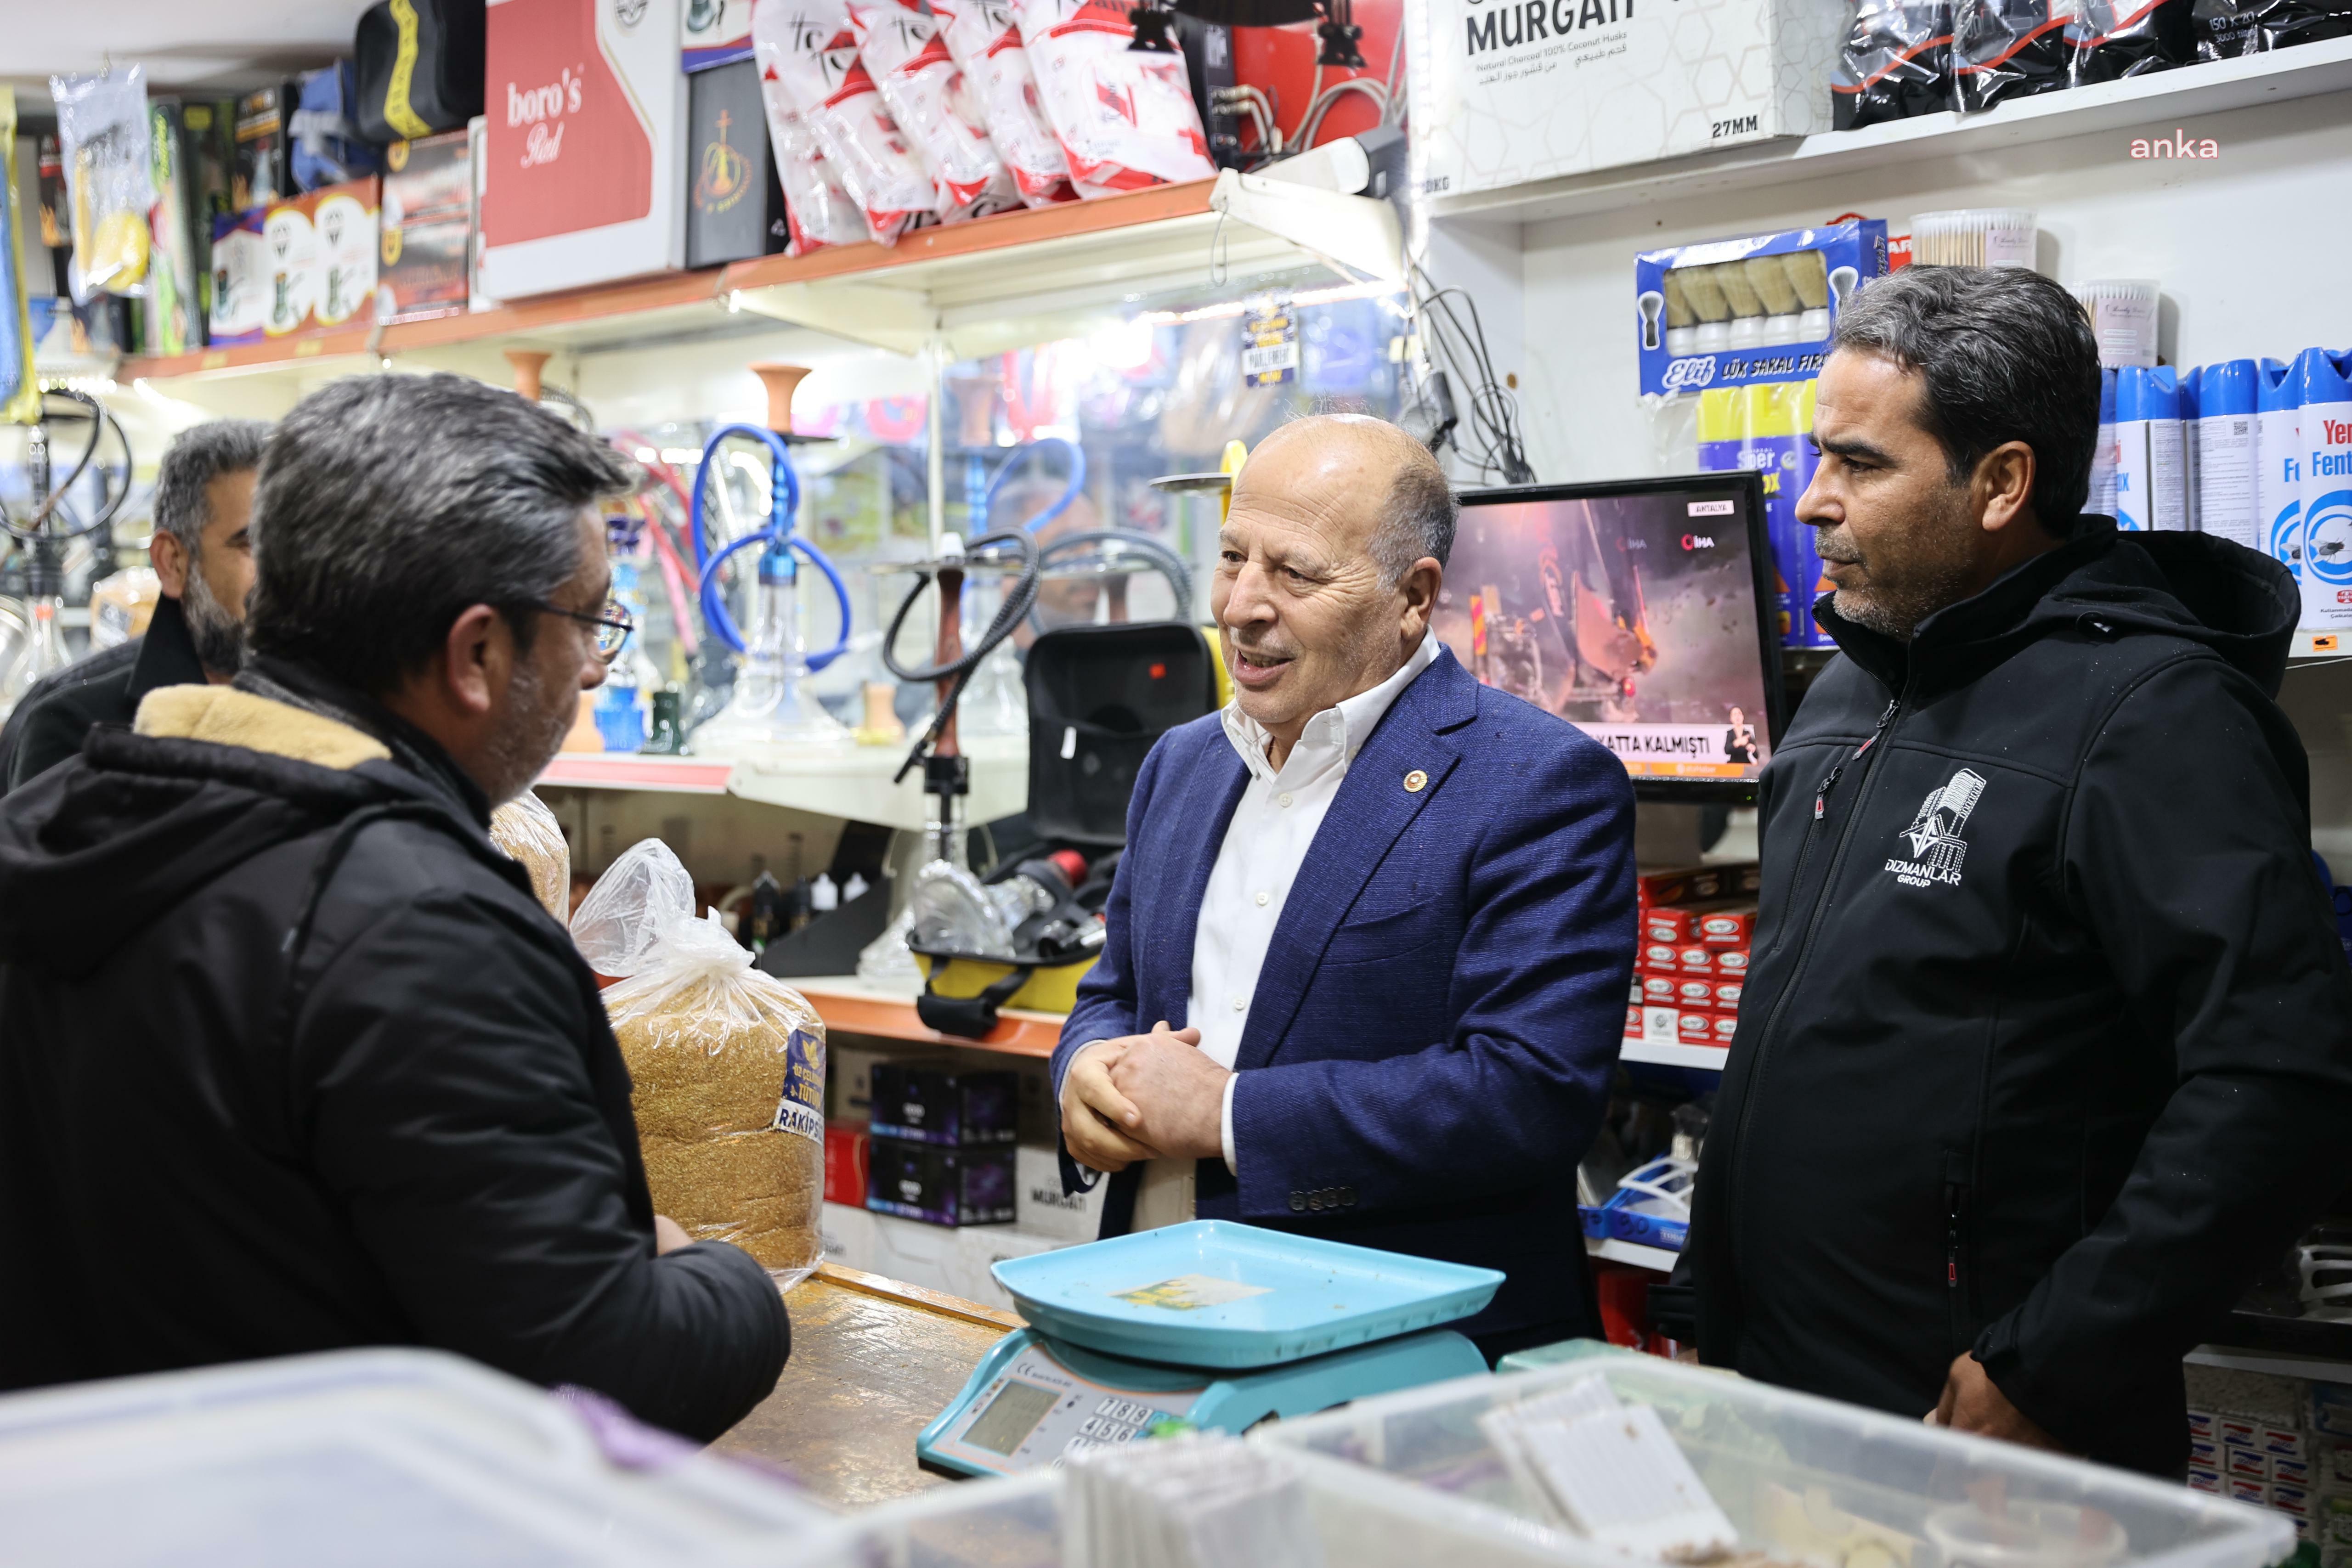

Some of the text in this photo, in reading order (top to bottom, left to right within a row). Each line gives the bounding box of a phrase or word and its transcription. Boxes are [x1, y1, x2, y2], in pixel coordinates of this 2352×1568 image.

[2209, 17, 2226, 31] 150
[2214, 31, 2235, 44] 3000
[1476, 30, 1628, 73] Natural Charcoal 100% Coconut Husks
[507, 67, 582, 128] boro's
[1712, 115, 1758, 138] 27MM
[1662, 355, 1716, 389] Elif
[1750, 356, 1794, 377] SAKAL
[1696, 503, 1728, 513] ANTALYA
[1645, 735, 1711, 759] KALMIŞTI
[1884, 858, 1962, 886] DIZMANLAR
[1897, 874, 1931, 888] GROUP
[1118, 1405, 1130, 1417] 8
[1134, 1410, 1147, 1421] 9
[1104, 1424, 1114, 1436] 5
[1118, 1429, 1130, 1442] 6
